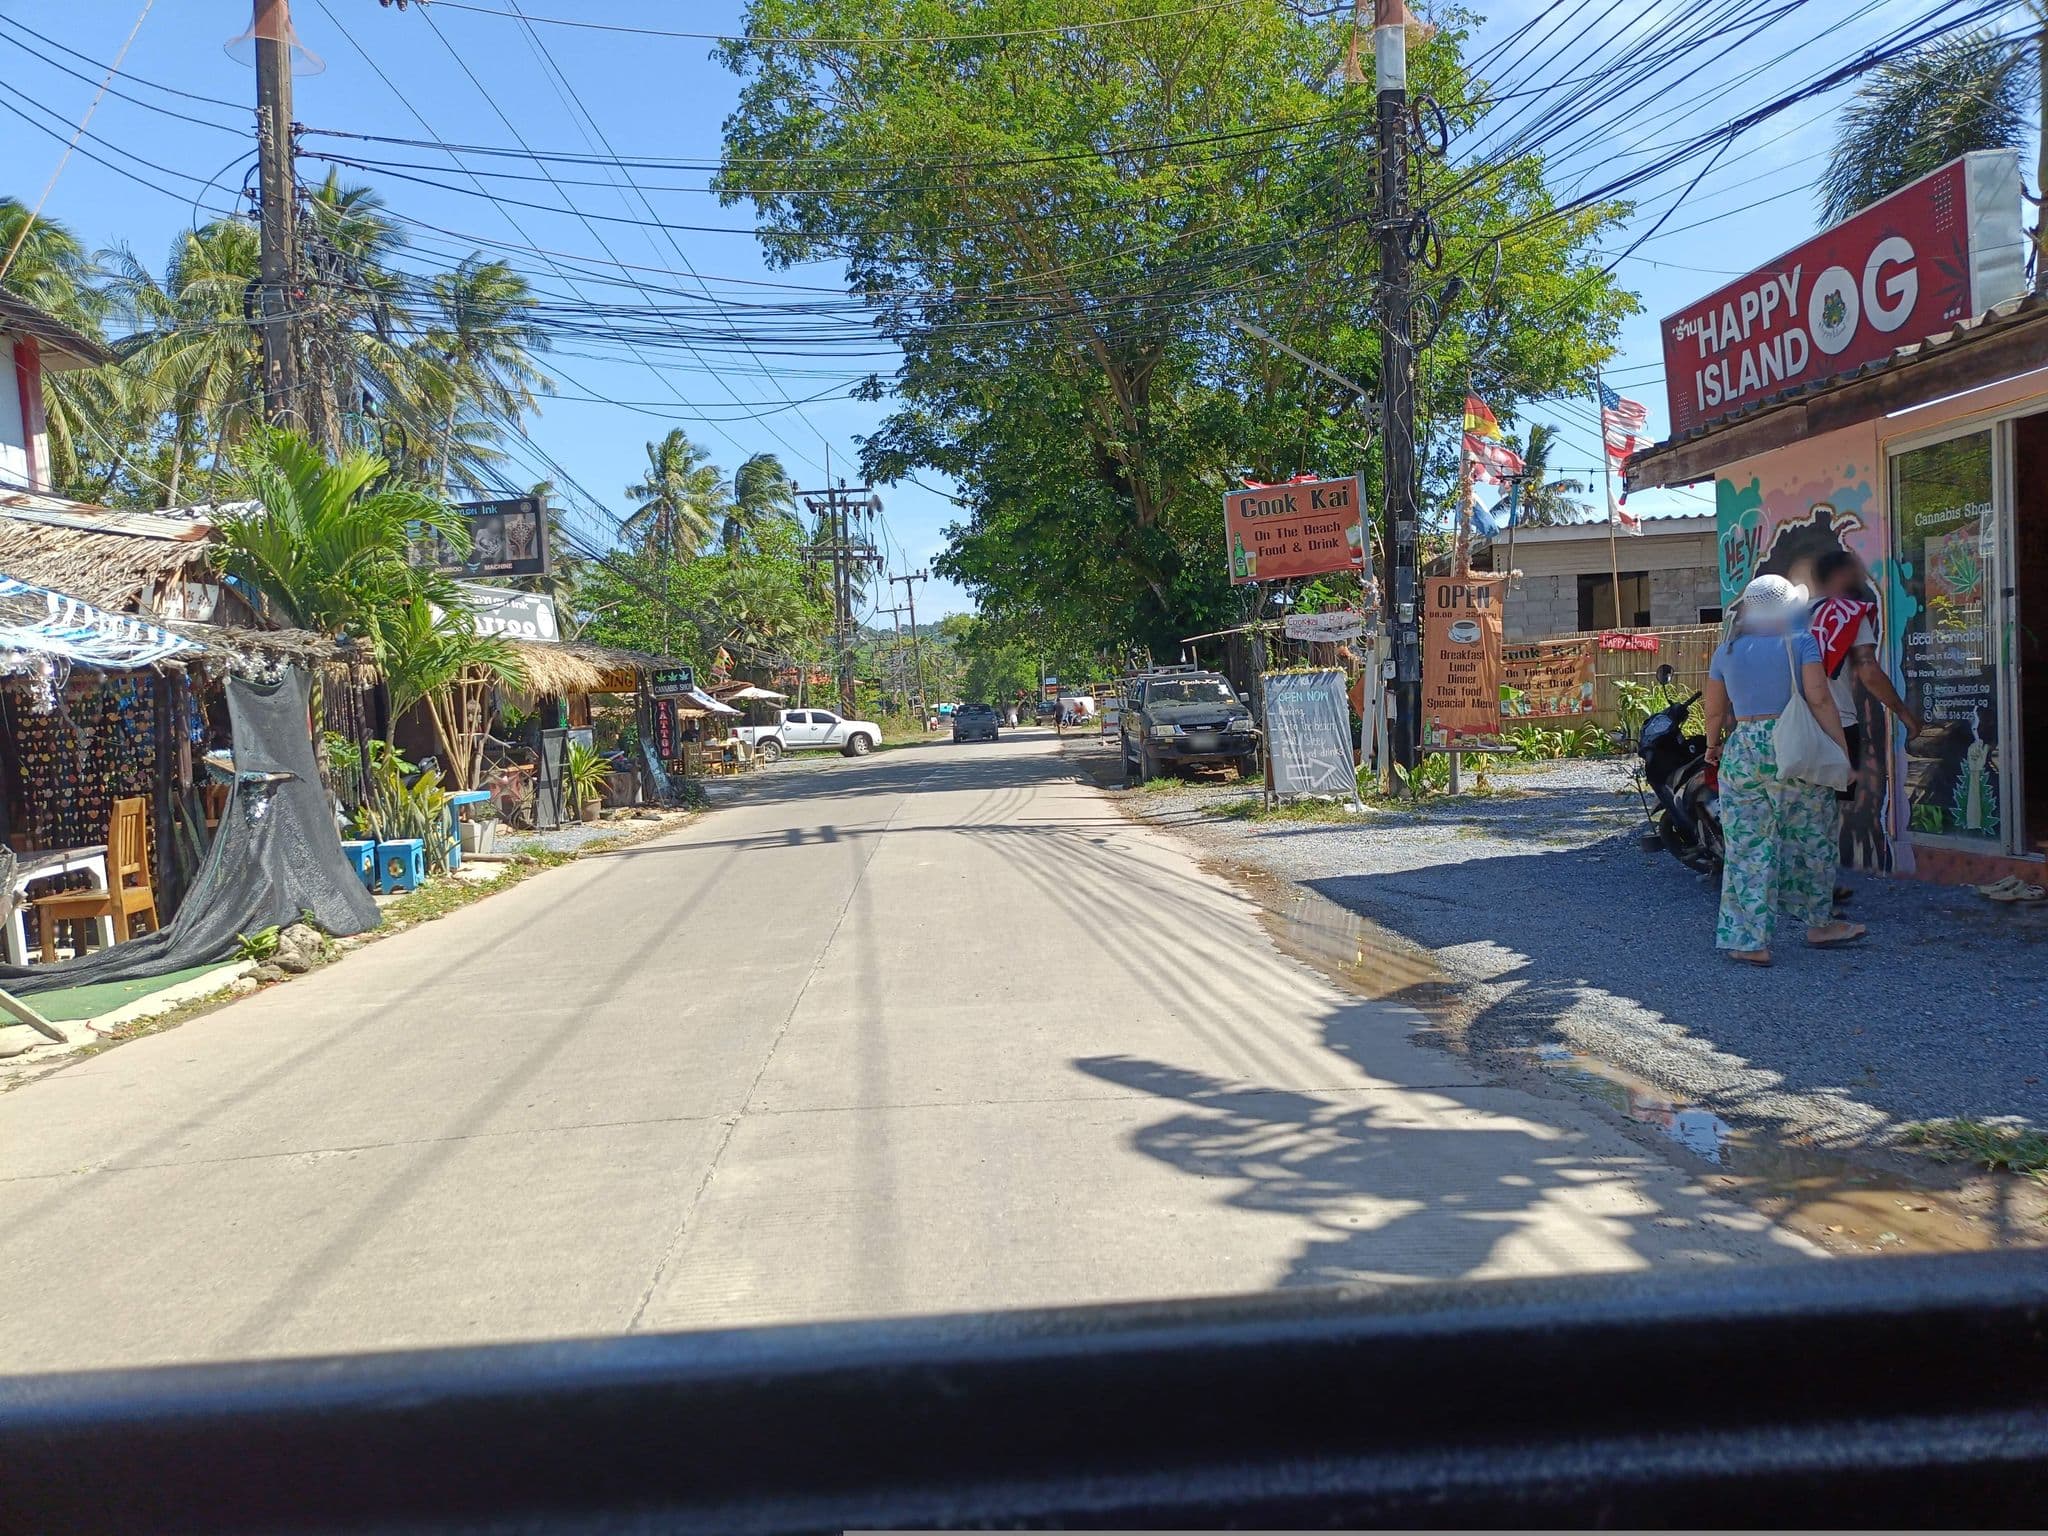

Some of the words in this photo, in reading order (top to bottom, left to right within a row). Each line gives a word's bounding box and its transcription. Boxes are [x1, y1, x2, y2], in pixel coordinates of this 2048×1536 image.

[1808, 236, 1918, 355] OG
[1696, 264, 1802, 358] HAPPY
[1696, 327, 1809, 411] ISLAND
[1240, 493, 1298, 518] Cook
[1310, 486, 1350, 509] Kai
[481, 504, 498, 515] Ink
[1914, 507, 1961, 527] Cannabis
[1964, 502, 1993, 517] Shop
[1254, 530, 1270, 542] On
[1276, 527, 1298, 539] The
[1304, 521, 1341, 536] Beach
[1258, 544, 1287, 557] Food
[1292, 542, 1303, 553] &
[1308, 538, 1340, 551] Drink
[1724, 525, 1763, 575] HEY!
[484, 562, 513, 572] MACHINE
[1437, 584, 1490, 608] OPEN
[1631, 637, 1655, 649] HOUR
[1908, 632, 1934, 646] Local
[1440, 650, 1486, 660] Breakfast
[1449, 662, 1476, 672] Lunch
[1505, 669, 1519, 678] On
[1523, 668, 1541, 677] The
[1545, 665, 1576, 676] Beach
[1918, 669, 1935, 677] Have
[1447, 674, 1477, 684] Dinner
[1549, 678, 1574, 688] Drink
[654, 685, 678, 693] CANNABIS
[1437, 686, 1456, 696] Thai
[1461, 686, 1482, 697] food
[1279, 692, 1303, 702] OPEN
[1306, 691, 1329, 702] NOW
[1427, 699, 1466, 709] Speacial
[658, 701, 671, 757] TATTOO
